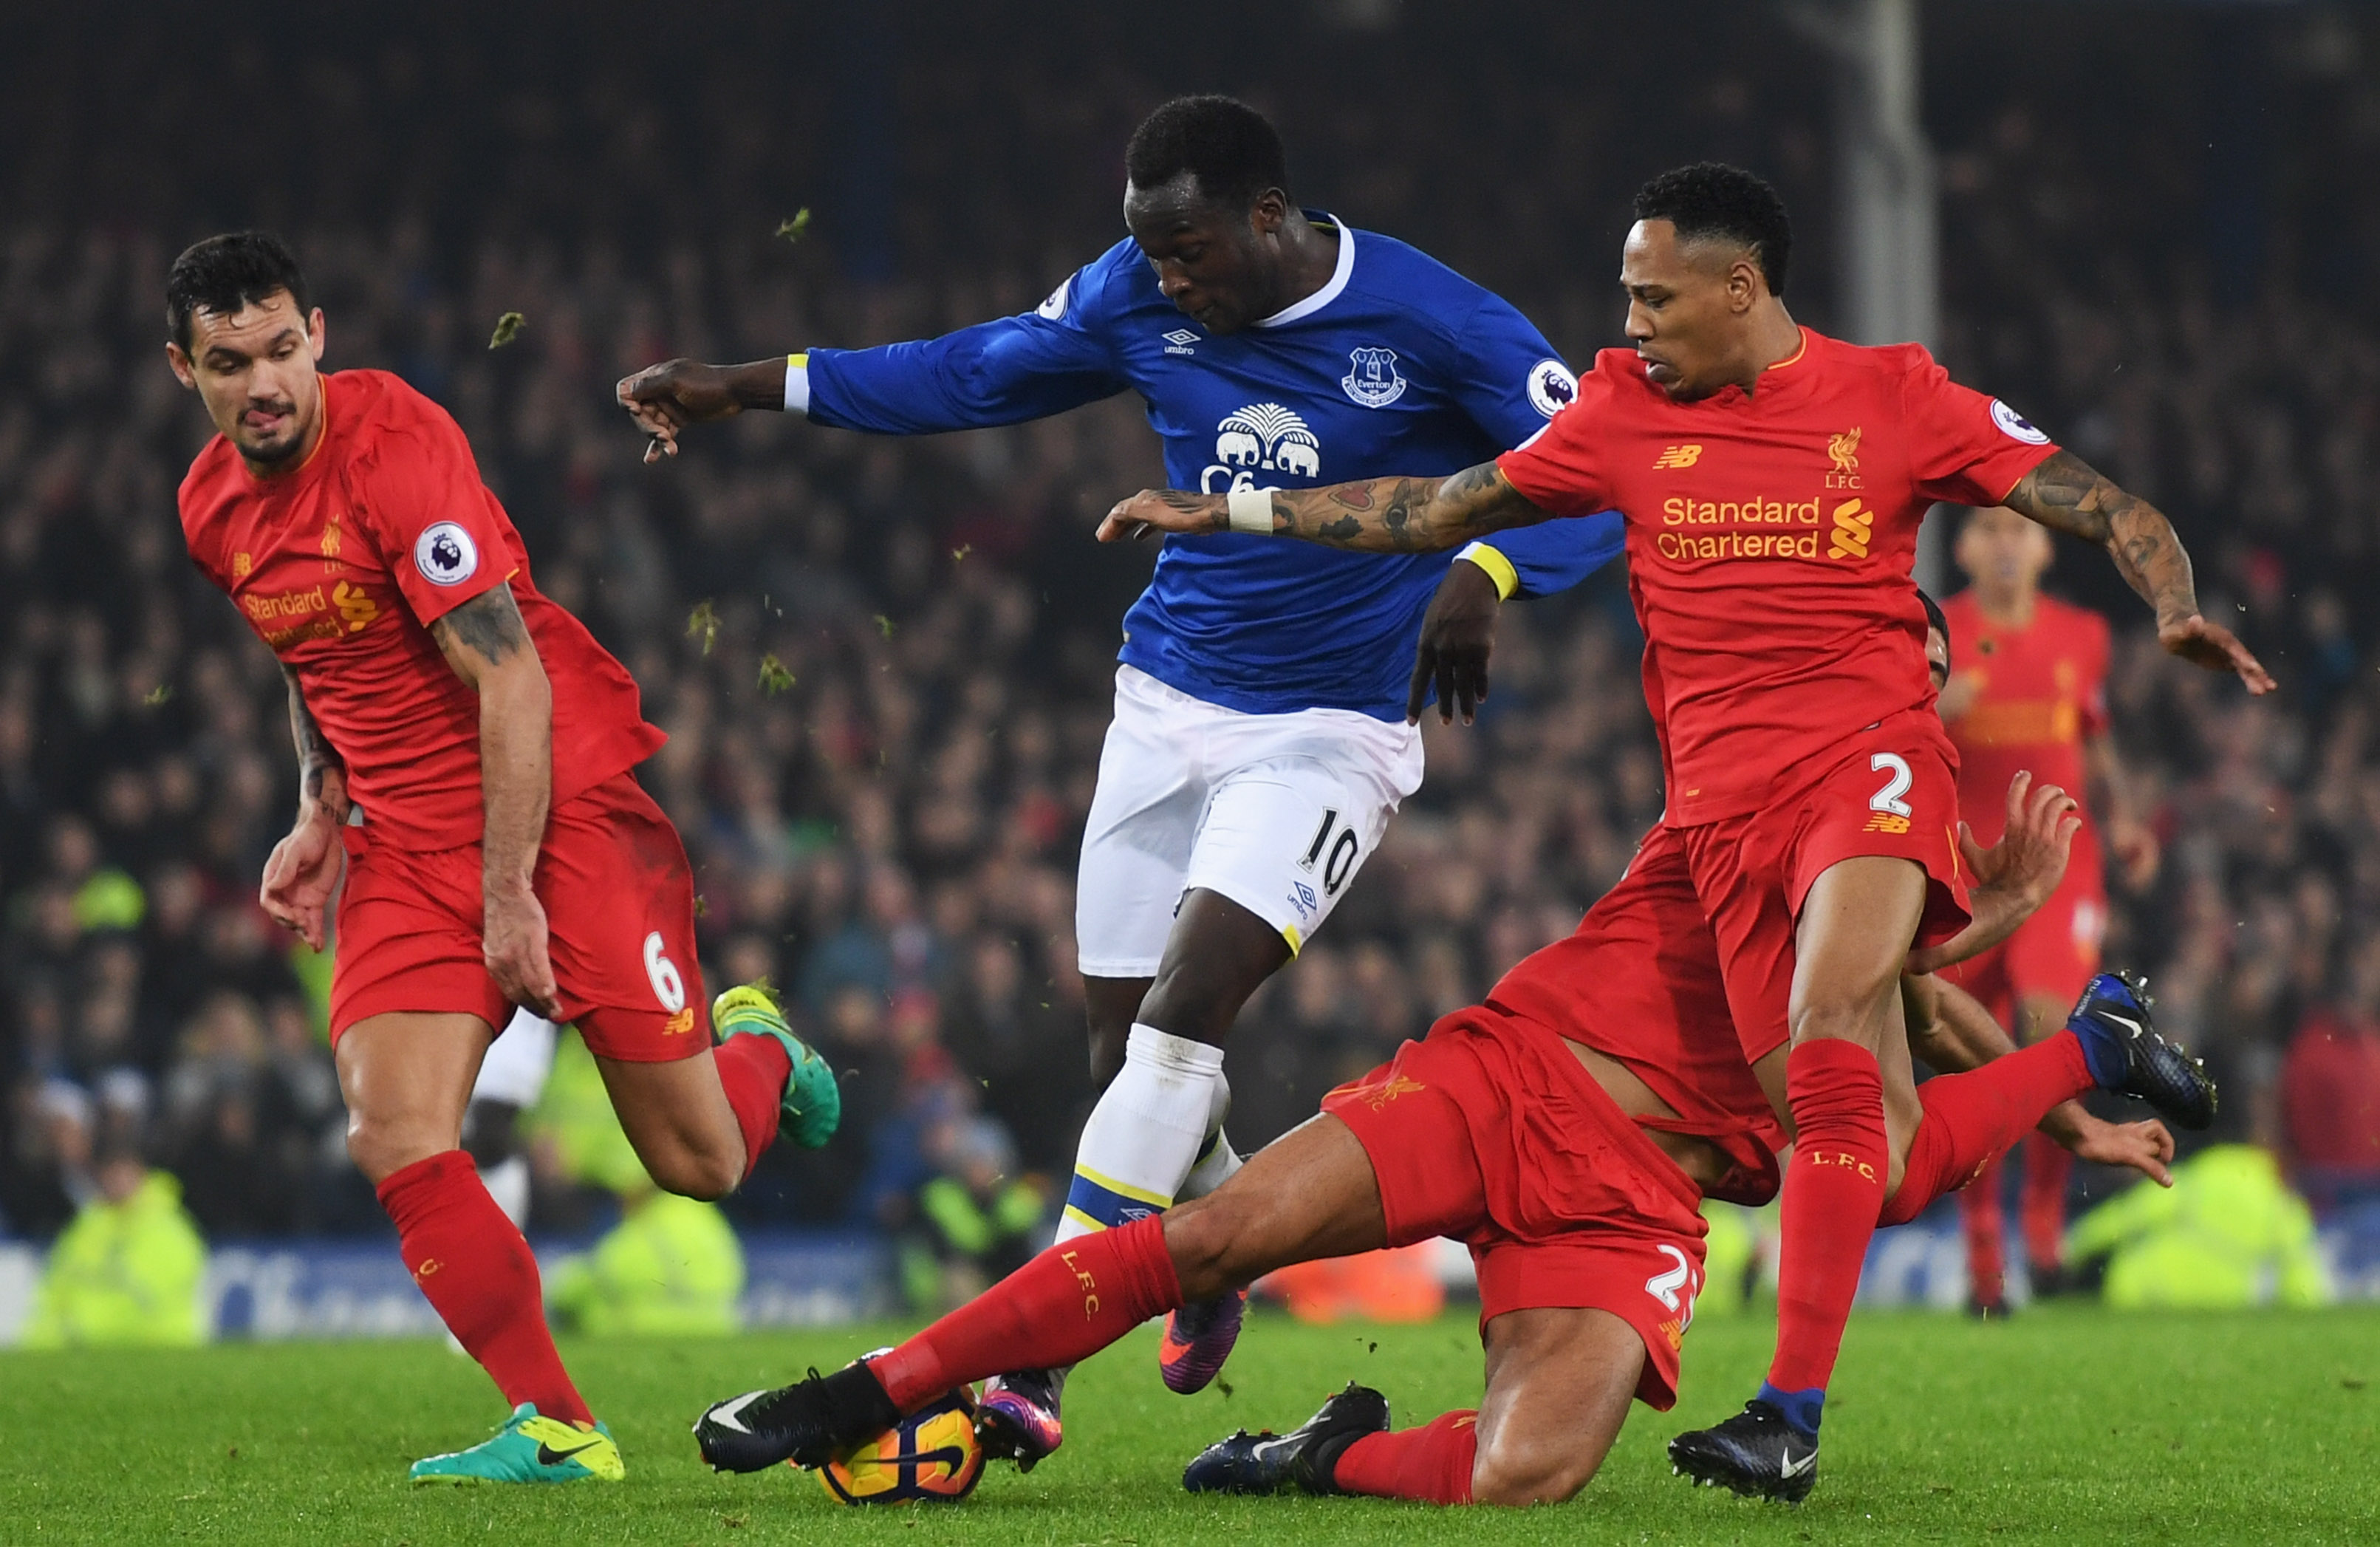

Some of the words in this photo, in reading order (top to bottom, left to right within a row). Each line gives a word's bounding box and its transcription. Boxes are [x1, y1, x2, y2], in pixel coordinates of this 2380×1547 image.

[1164, 345, 1194, 355] umbro
[1358, 378, 1390, 389] Everton
[1662, 496, 1819, 526] Standard
[1658, 530, 1819, 559] Chartered
[245, 584, 327, 621] Standard
[1870, 752, 1912, 818] 2
[1298, 807, 1358, 898] 10
[1288, 894, 1308, 921] umbro
[643, 931, 685, 1012] 6
[1813, 1151, 1877, 1184] L.F.C.
[1061, 1251, 1099, 1322] L.F.C.
